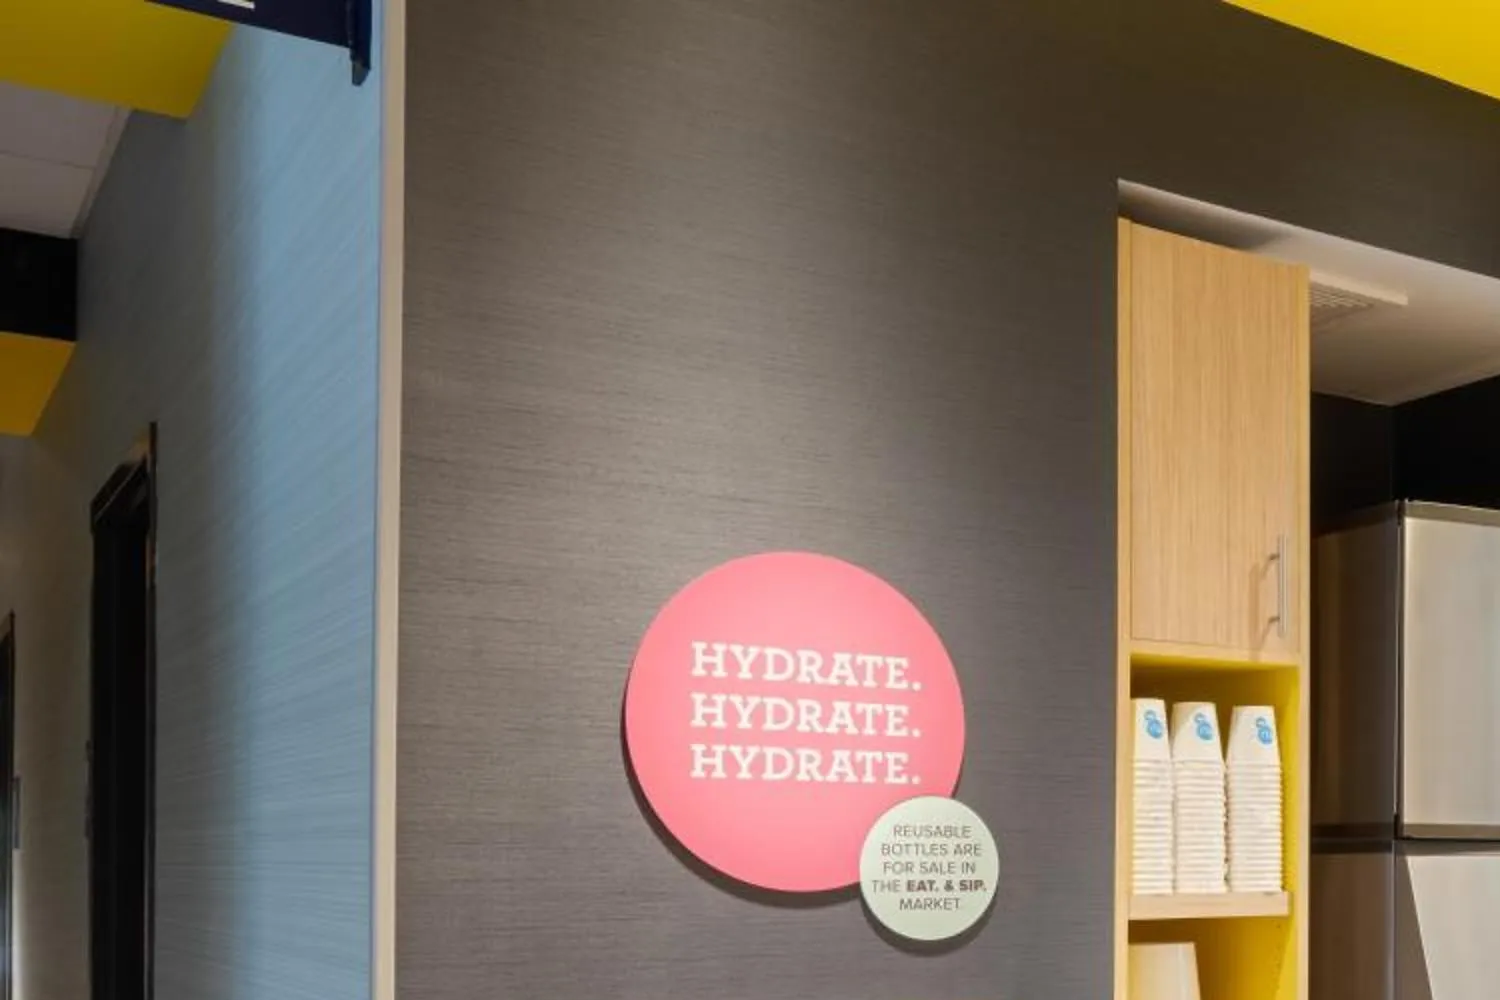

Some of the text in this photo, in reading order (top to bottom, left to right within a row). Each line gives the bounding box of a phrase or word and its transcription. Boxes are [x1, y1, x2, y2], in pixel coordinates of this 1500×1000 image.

[690, 641, 922, 691] HYDRATE.
[690, 692, 921, 738] HYDRATE.
[690, 743, 921, 785] HYDRATE.
[893, 825, 972, 838] REUSABLE
[881, 843, 982, 857] BOTTLES ARE
[883, 861, 976, 875] FOR SALE IN
[872, 879, 987, 893] THE EAT. & SIP.
[899, 897, 960, 911] MARKET
